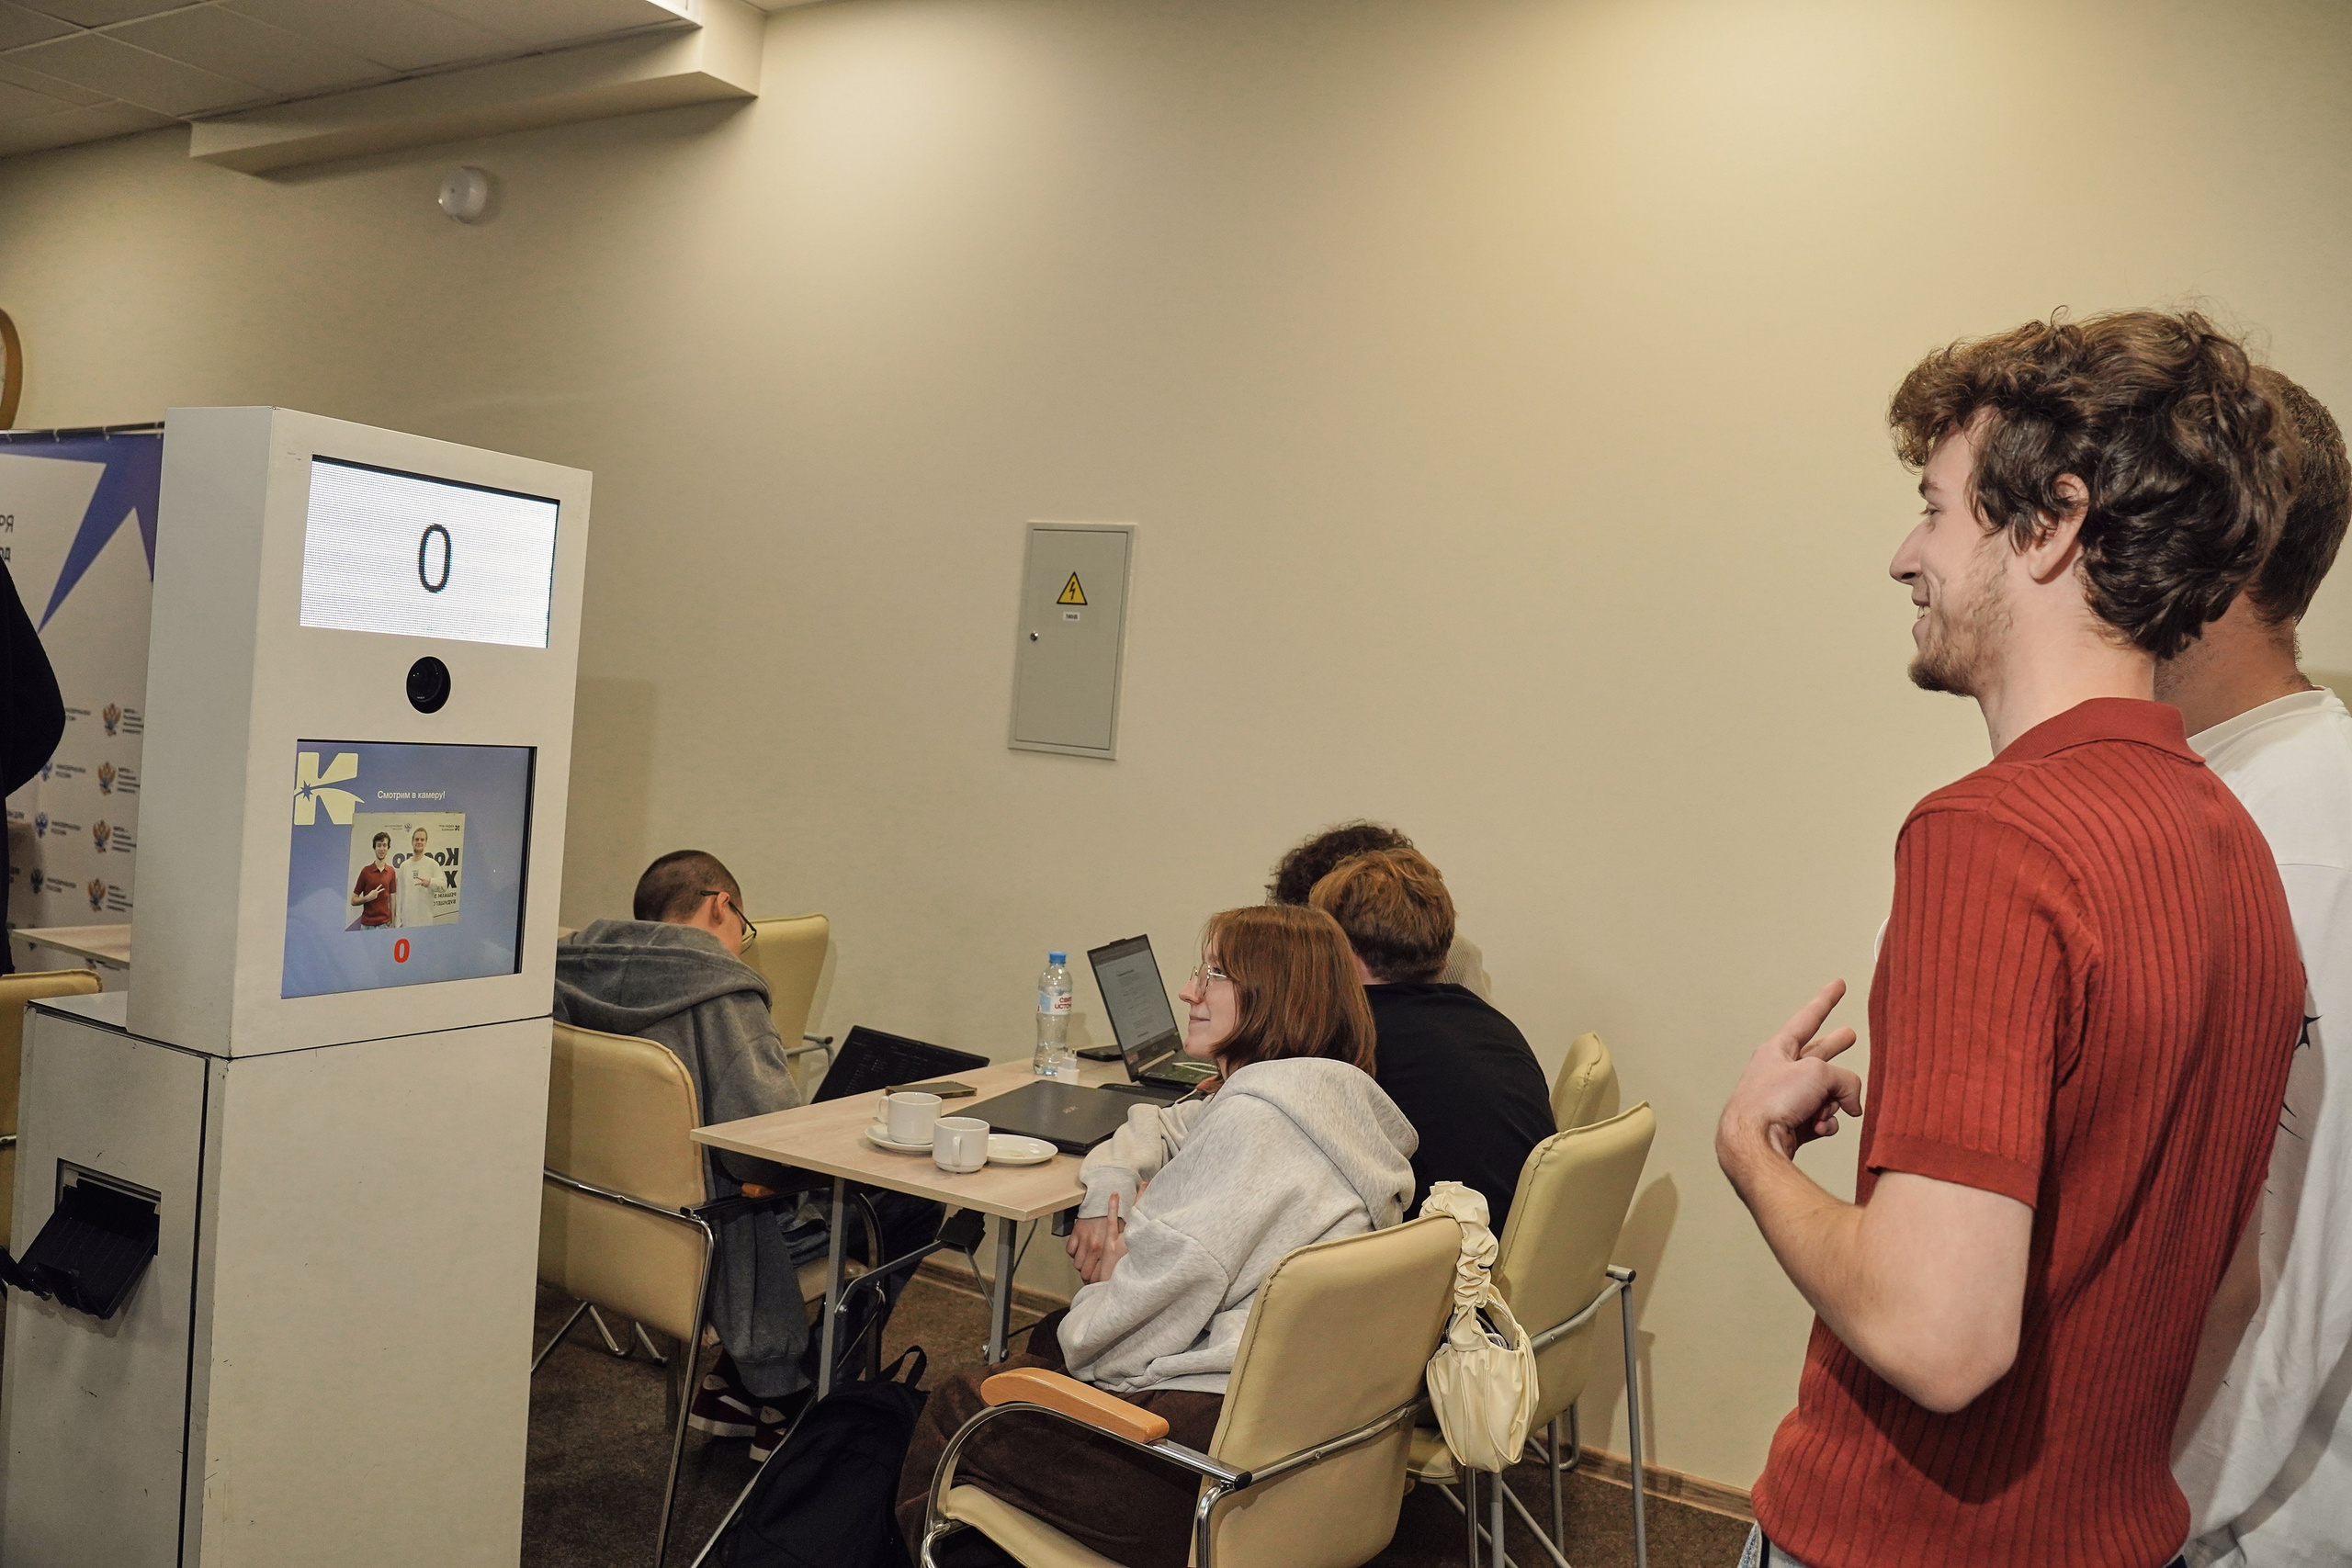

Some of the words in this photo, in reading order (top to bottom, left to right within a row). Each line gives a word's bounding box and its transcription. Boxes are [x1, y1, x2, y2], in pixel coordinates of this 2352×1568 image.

[418, 524, 451, 593] 0
[377, 790, 411, 800] Смотрим
[417, 791, 446, 800] камеру!
[394, 938, 410, 963] 0
